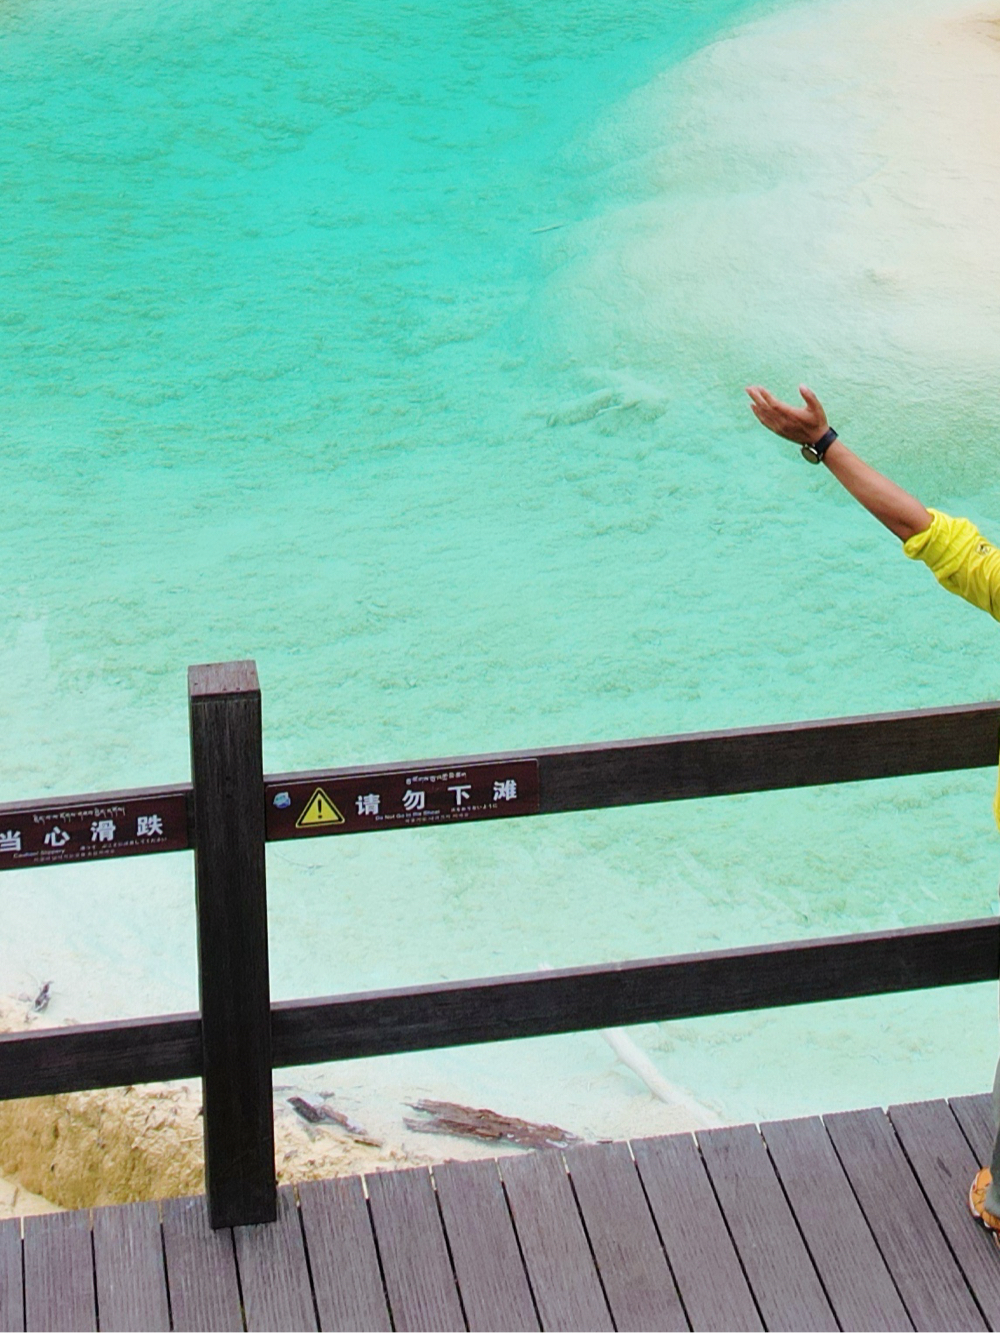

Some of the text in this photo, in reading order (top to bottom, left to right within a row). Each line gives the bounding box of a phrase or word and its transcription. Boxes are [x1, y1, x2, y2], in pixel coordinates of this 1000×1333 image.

[354, 779, 518, 817] 请勿下滩
[0, 813, 164, 853] 当心滑跌
